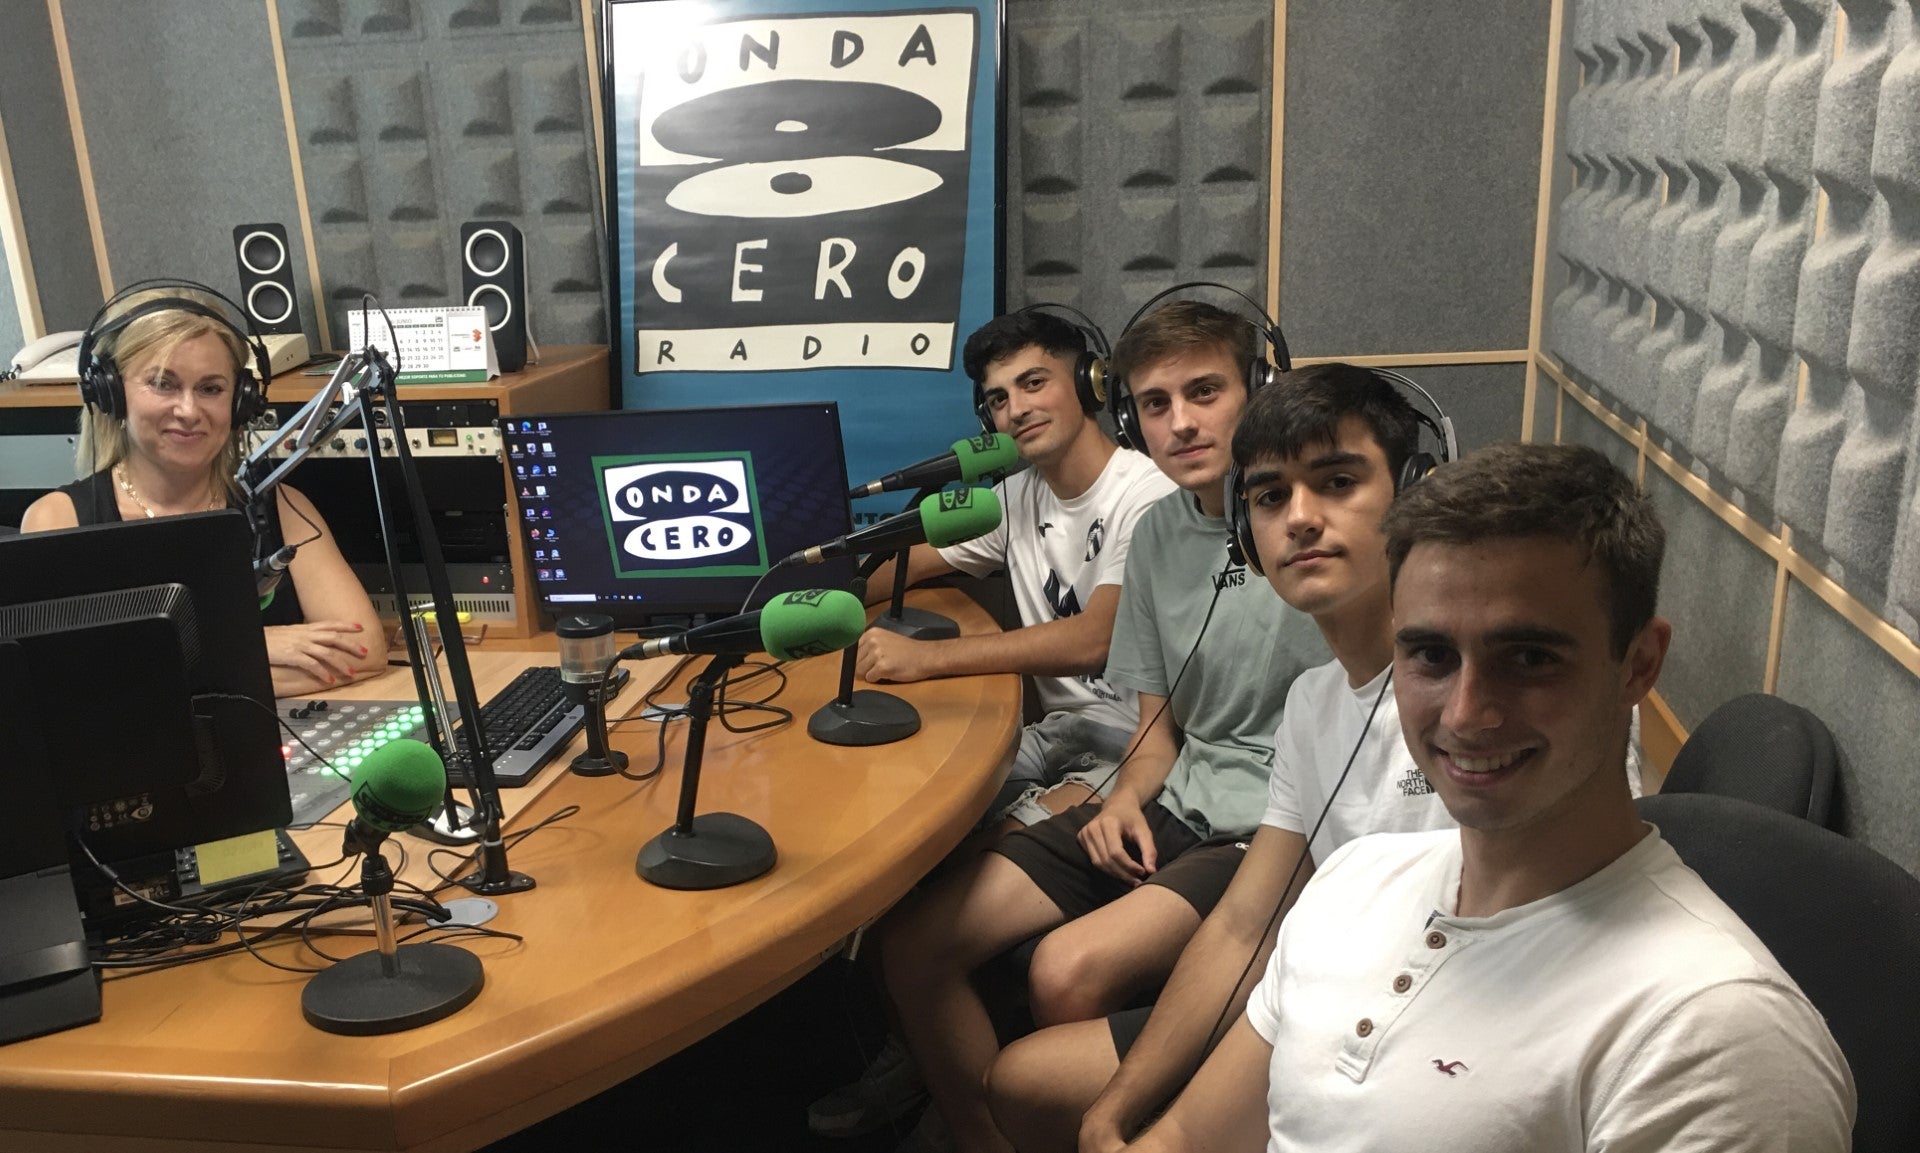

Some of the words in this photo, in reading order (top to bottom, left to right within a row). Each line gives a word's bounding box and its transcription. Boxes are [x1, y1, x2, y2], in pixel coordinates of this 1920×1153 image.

[677, 23, 937, 84] ONDA
[651, 236, 926, 303] CERO
[656, 333, 931, 365] RADIO
[626, 483, 728, 509] ONDA
[640, 525, 734, 552] CERO
[1211, 568, 1246, 590] VANS
[1396, 777, 1426, 790] NORTH
[1405, 769, 1425, 779] THE
[1402, 786, 1427, 797] FACE
